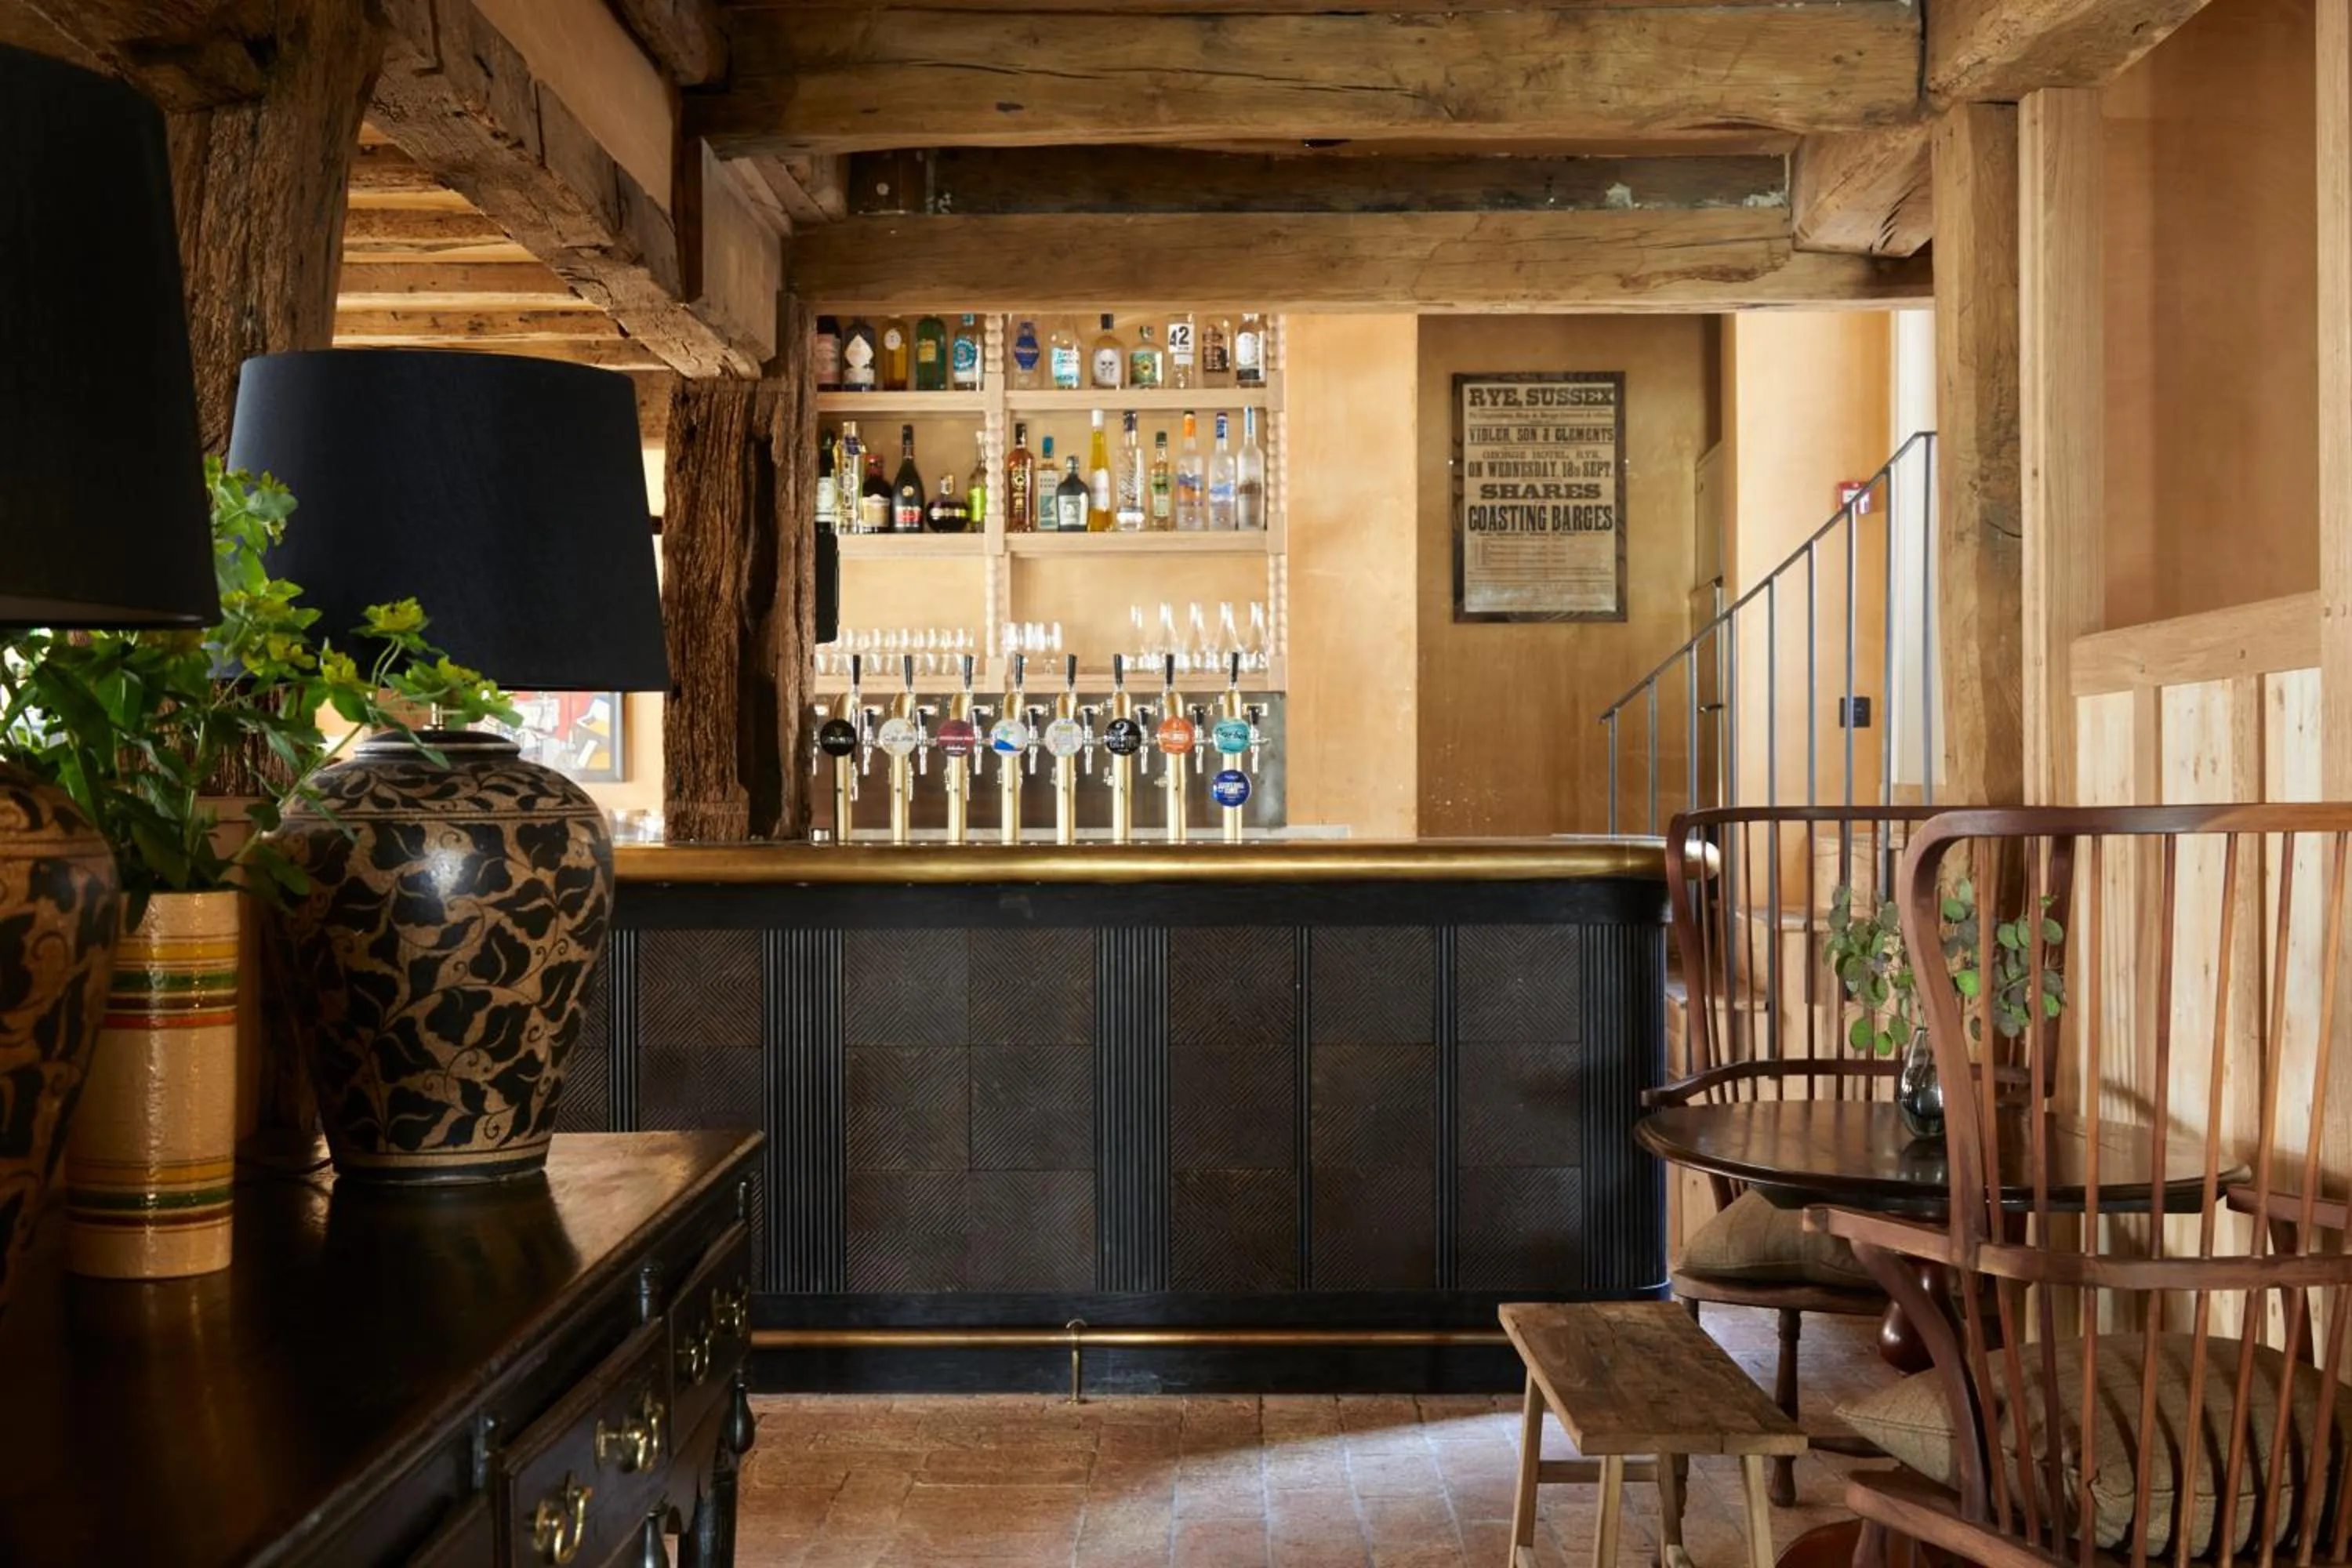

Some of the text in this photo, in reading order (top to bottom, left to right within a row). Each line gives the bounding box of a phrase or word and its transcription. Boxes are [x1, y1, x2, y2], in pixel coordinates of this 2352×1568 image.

[1170, 326, 1189, 347] 42
[1526, 387, 1614, 406] SUSSEX
[1517, 427, 1537, 441] SON
[1555, 427, 1614, 441] CLEMENTS
[1468, 461, 1483, 477] ON
[1480, 483, 1602, 500] SHARES
[1468, 505, 1613, 532] COASTING BARGES
